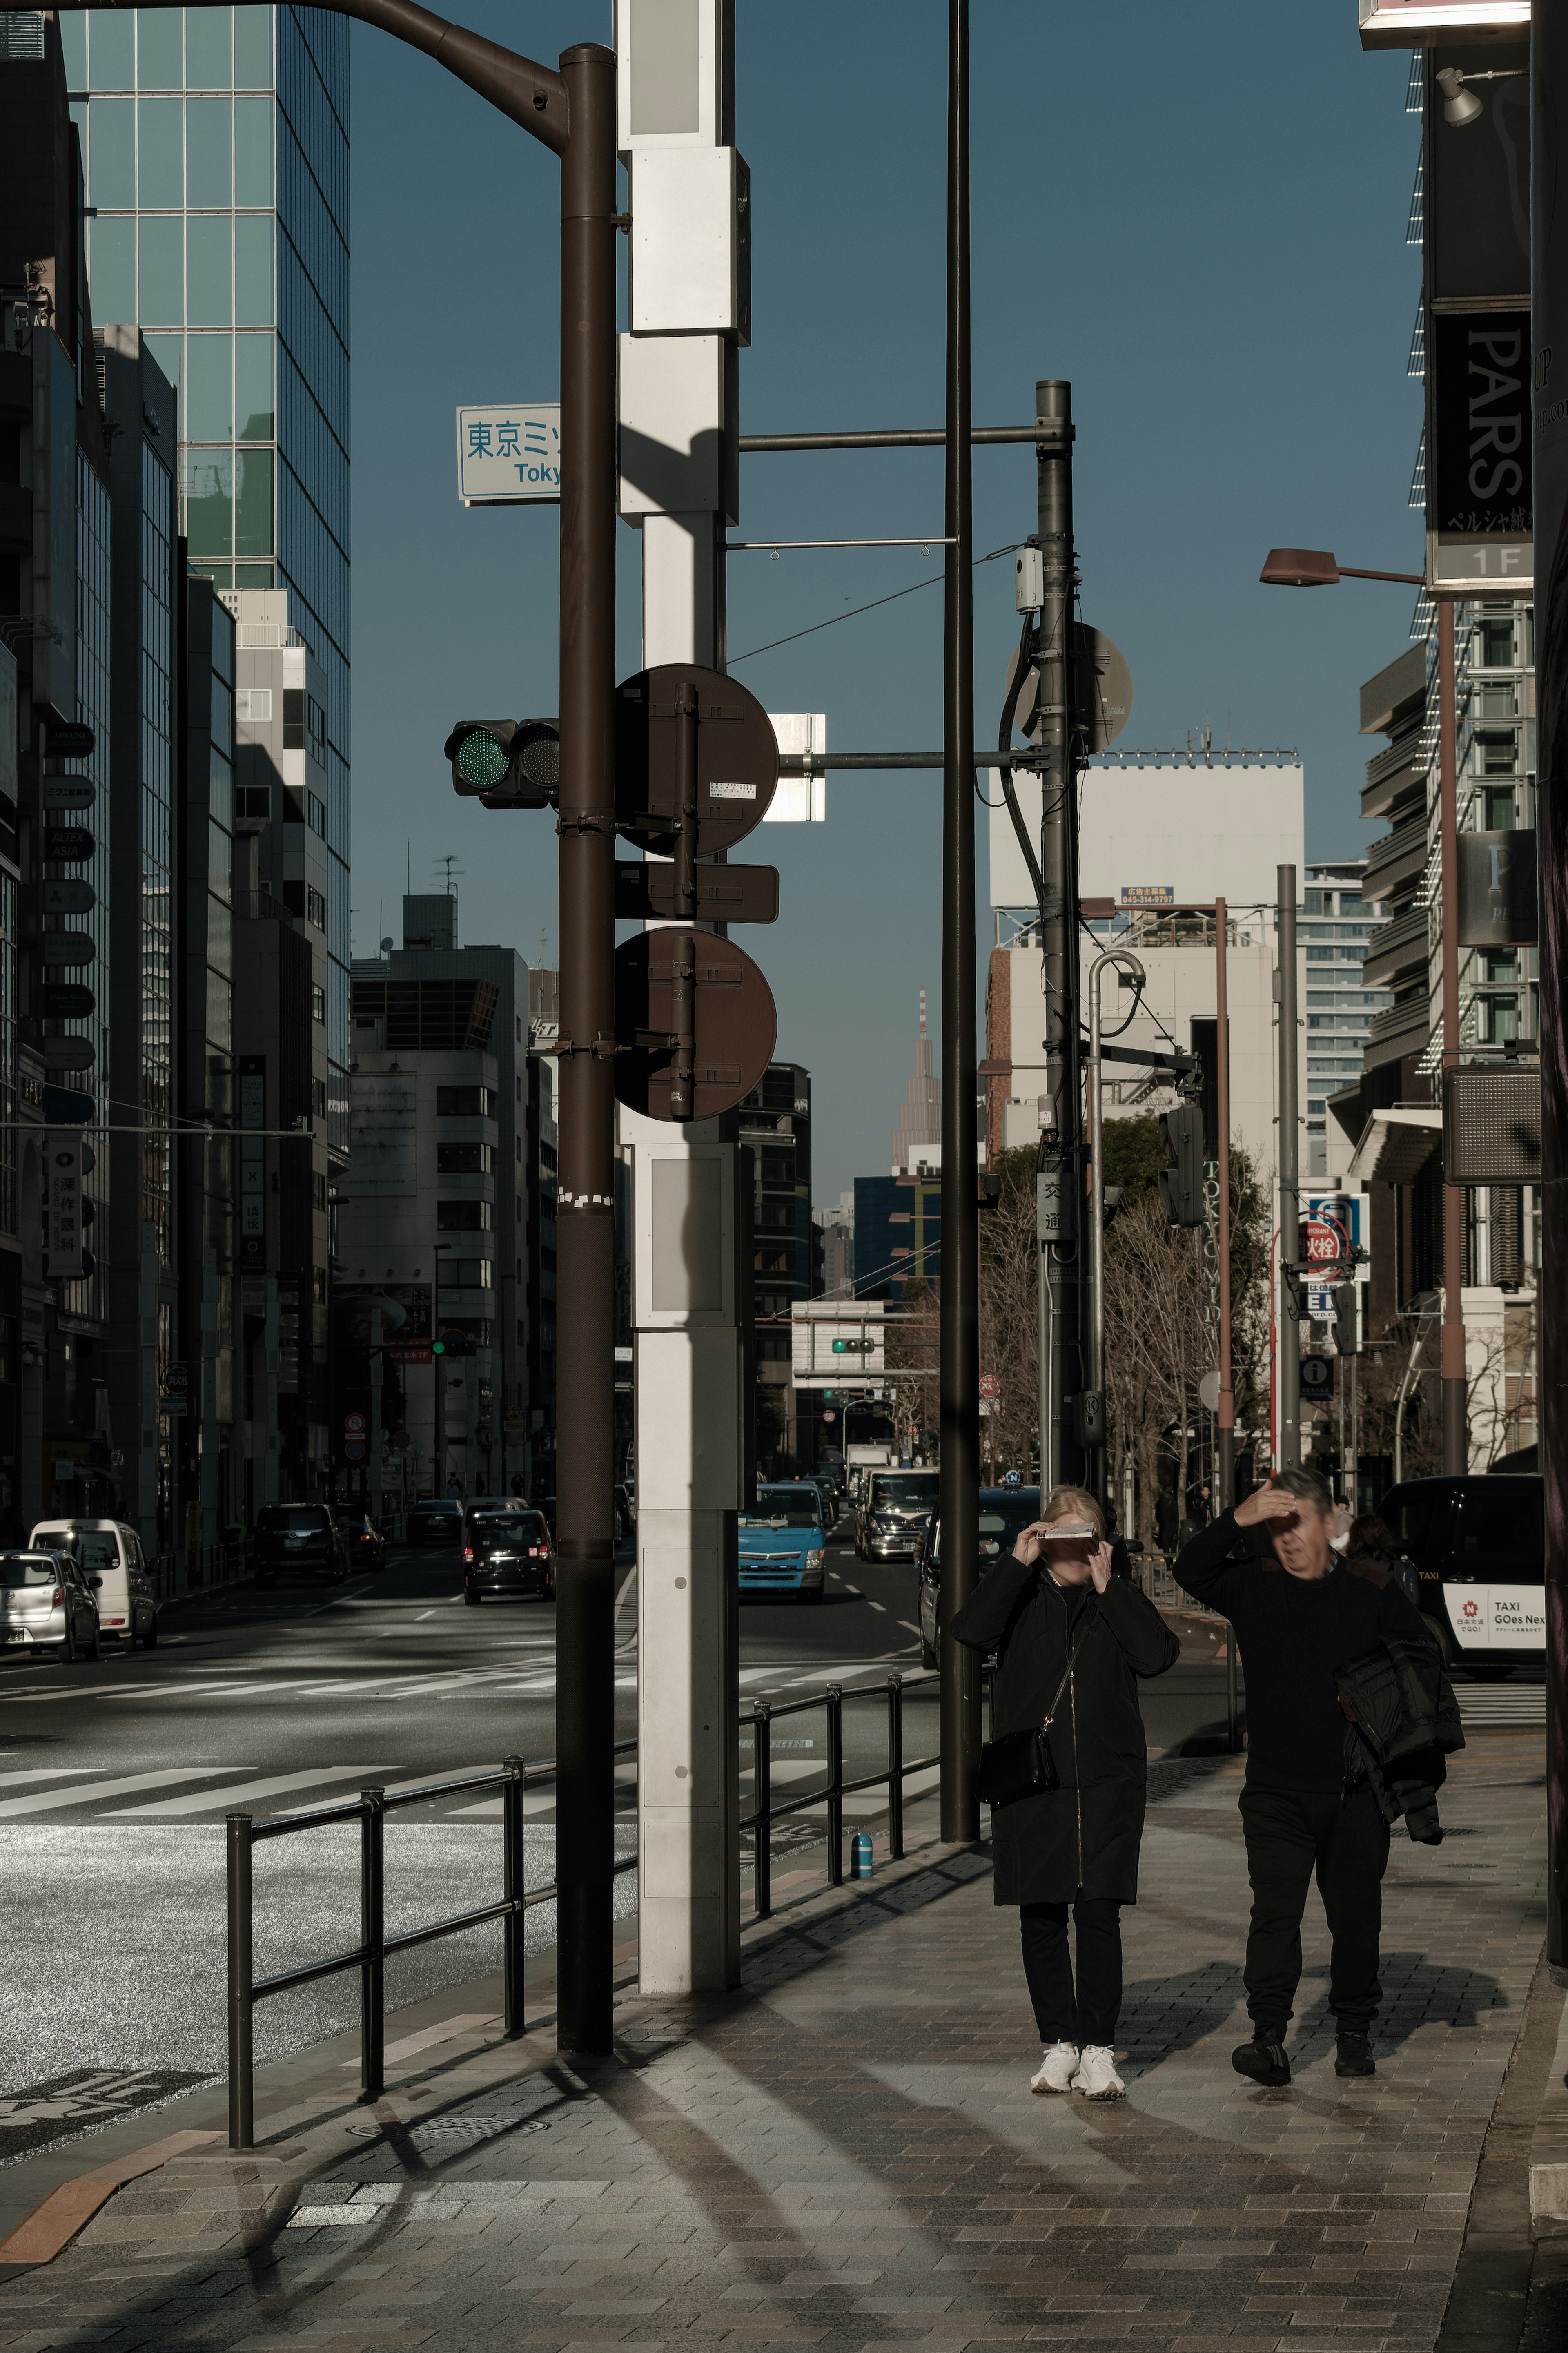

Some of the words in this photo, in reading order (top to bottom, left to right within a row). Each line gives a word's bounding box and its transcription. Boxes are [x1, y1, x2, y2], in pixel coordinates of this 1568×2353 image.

[1469, 328, 1523, 500] PARS
[1474, 548, 1521, 575] 1F
[52, 833, 84, 842] ALTEX
[52, 847, 79, 856] ASIA
[1490, 906, 1538, 922] PERS
[1045, 1182, 1061, 1230] 交通
[60, 1177, 76, 1252] 深作眼科
[1494, 1602, 1519, 1611] TAXI
[1494, 1615, 1522, 1624] GOes
